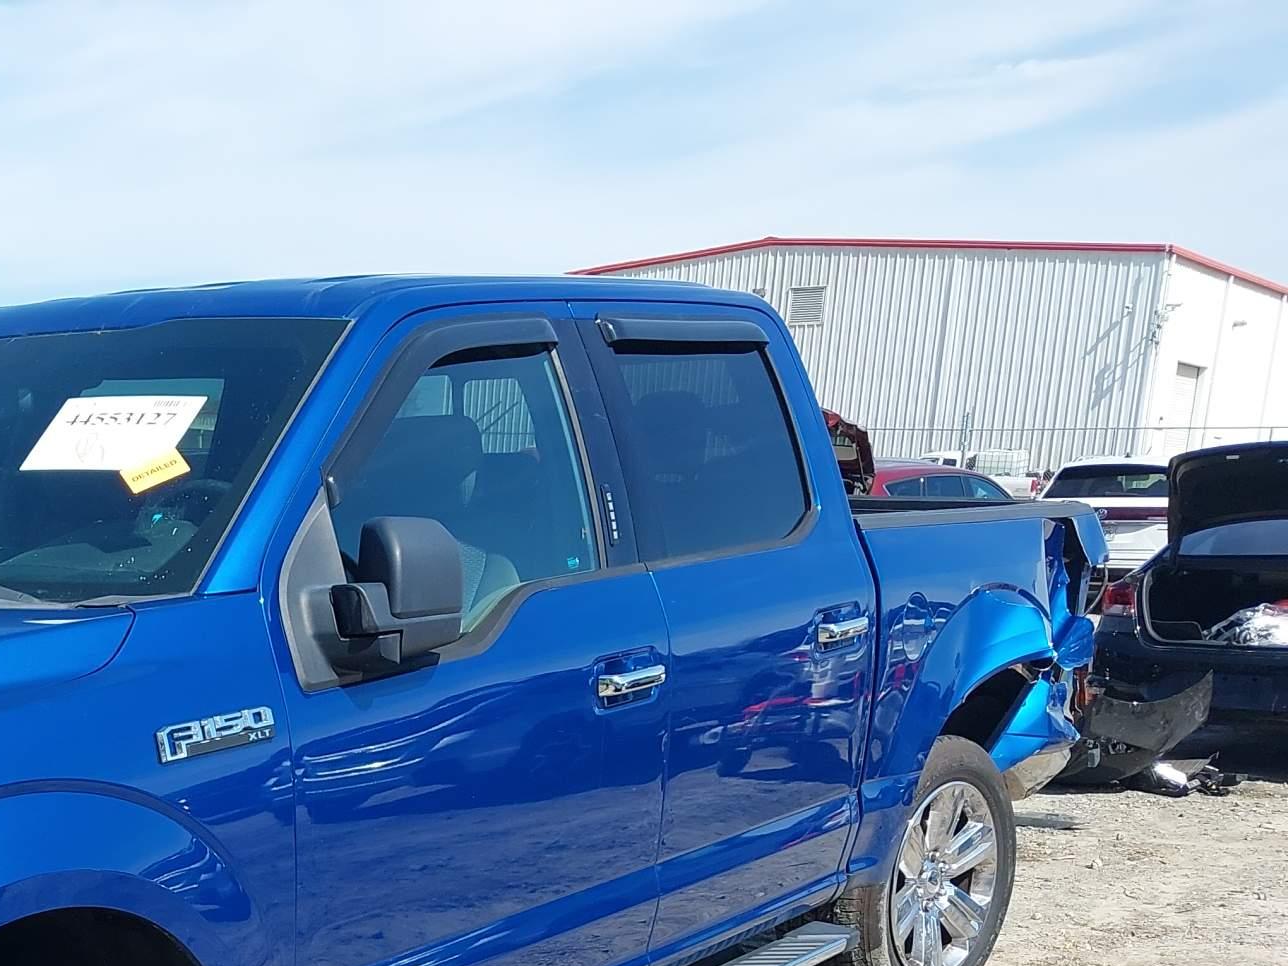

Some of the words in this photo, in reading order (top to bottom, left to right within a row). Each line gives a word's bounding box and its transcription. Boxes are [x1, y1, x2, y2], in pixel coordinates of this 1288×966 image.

[66, 411, 177, 426] 44553127
[131, 459, 178, 482] DETAILED
[248, 729, 272, 741] XLT
